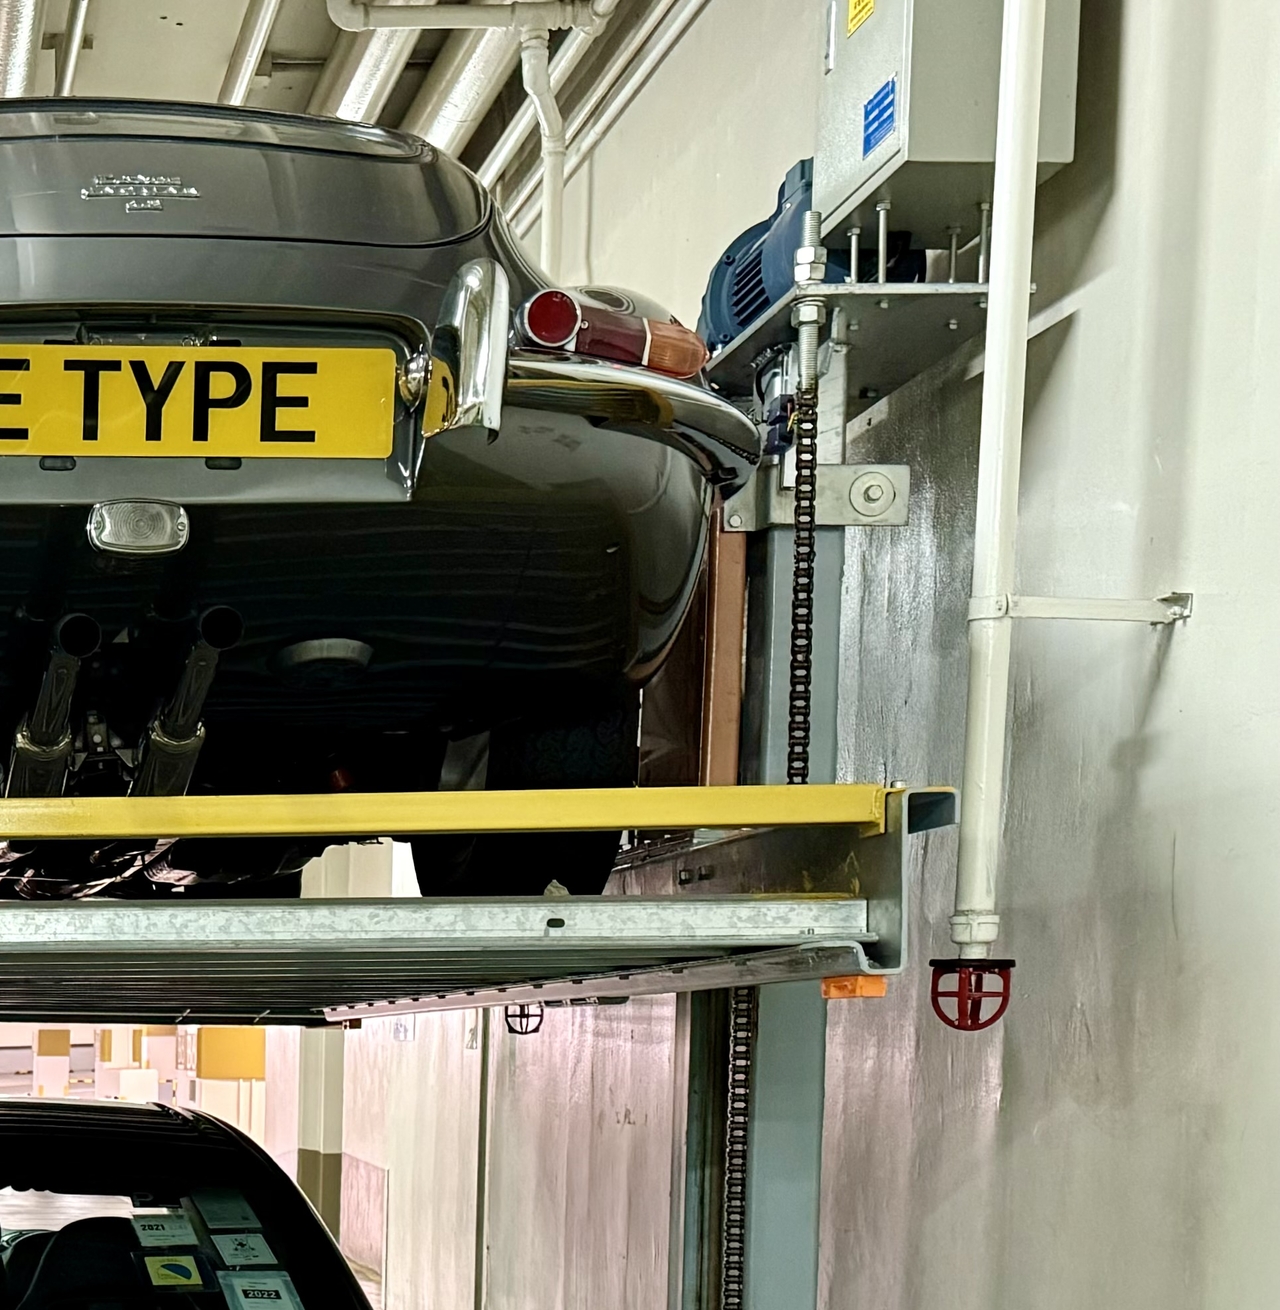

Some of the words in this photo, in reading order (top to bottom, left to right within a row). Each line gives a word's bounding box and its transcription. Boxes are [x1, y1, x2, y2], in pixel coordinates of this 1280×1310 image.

[63, 358, 319, 443] TYPE
[140, 1223, 166, 1232] 2021
[246, 1290, 277, 1299] 2022
